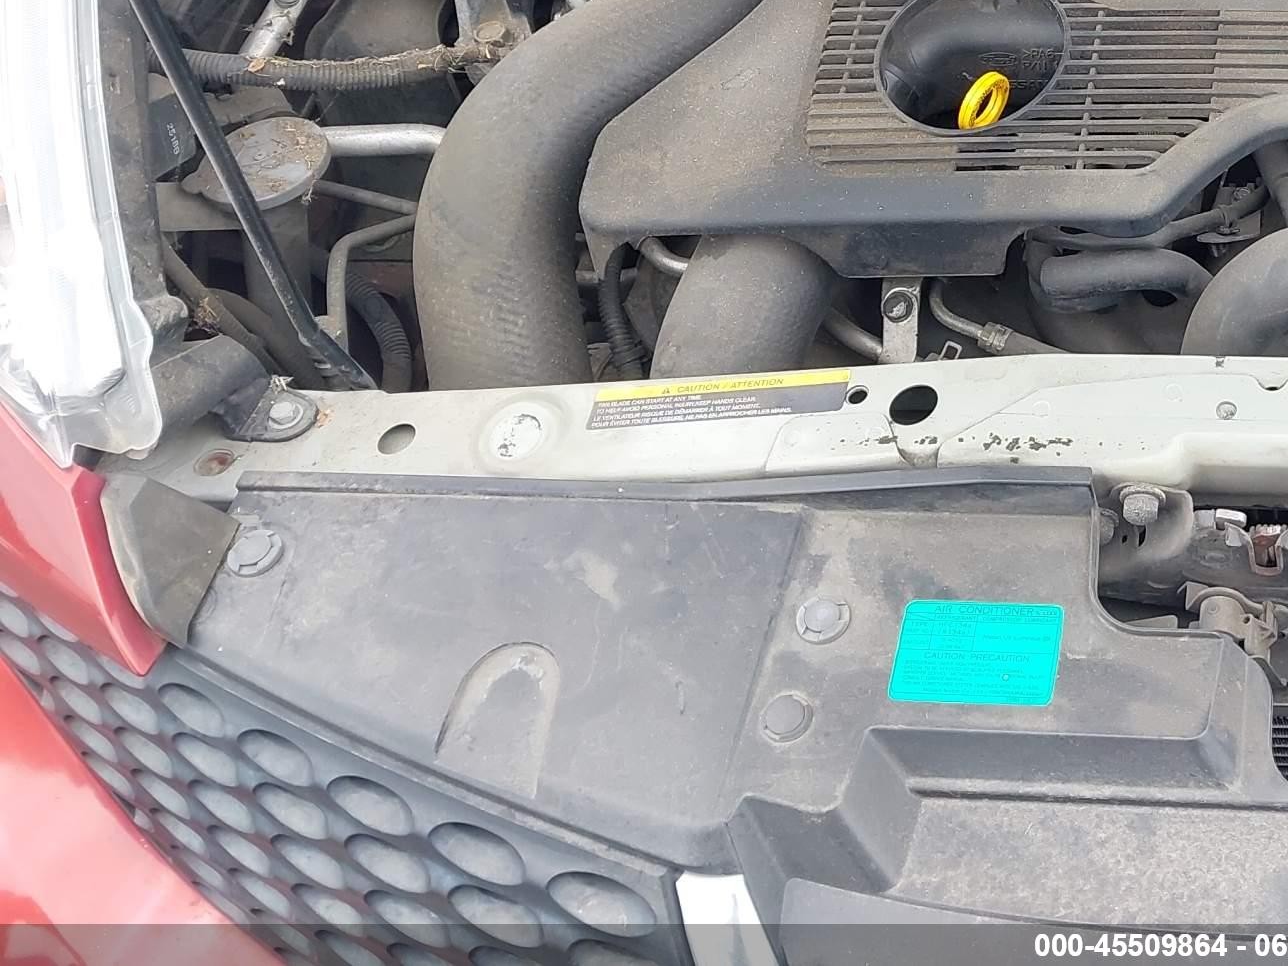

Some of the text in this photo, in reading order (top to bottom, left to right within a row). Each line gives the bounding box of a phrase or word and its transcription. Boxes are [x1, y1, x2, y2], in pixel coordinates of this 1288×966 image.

[677, 383, 720, 393] CAUTION
[731, 379, 784, 389] ATTENTION
[935, 605, 952, 613] AIR
[957, 605, 1033, 616] CONDITIONER
[924, 652, 964, 660] CAUTION
[969, 654, 1029, 663] PRECAUTION
